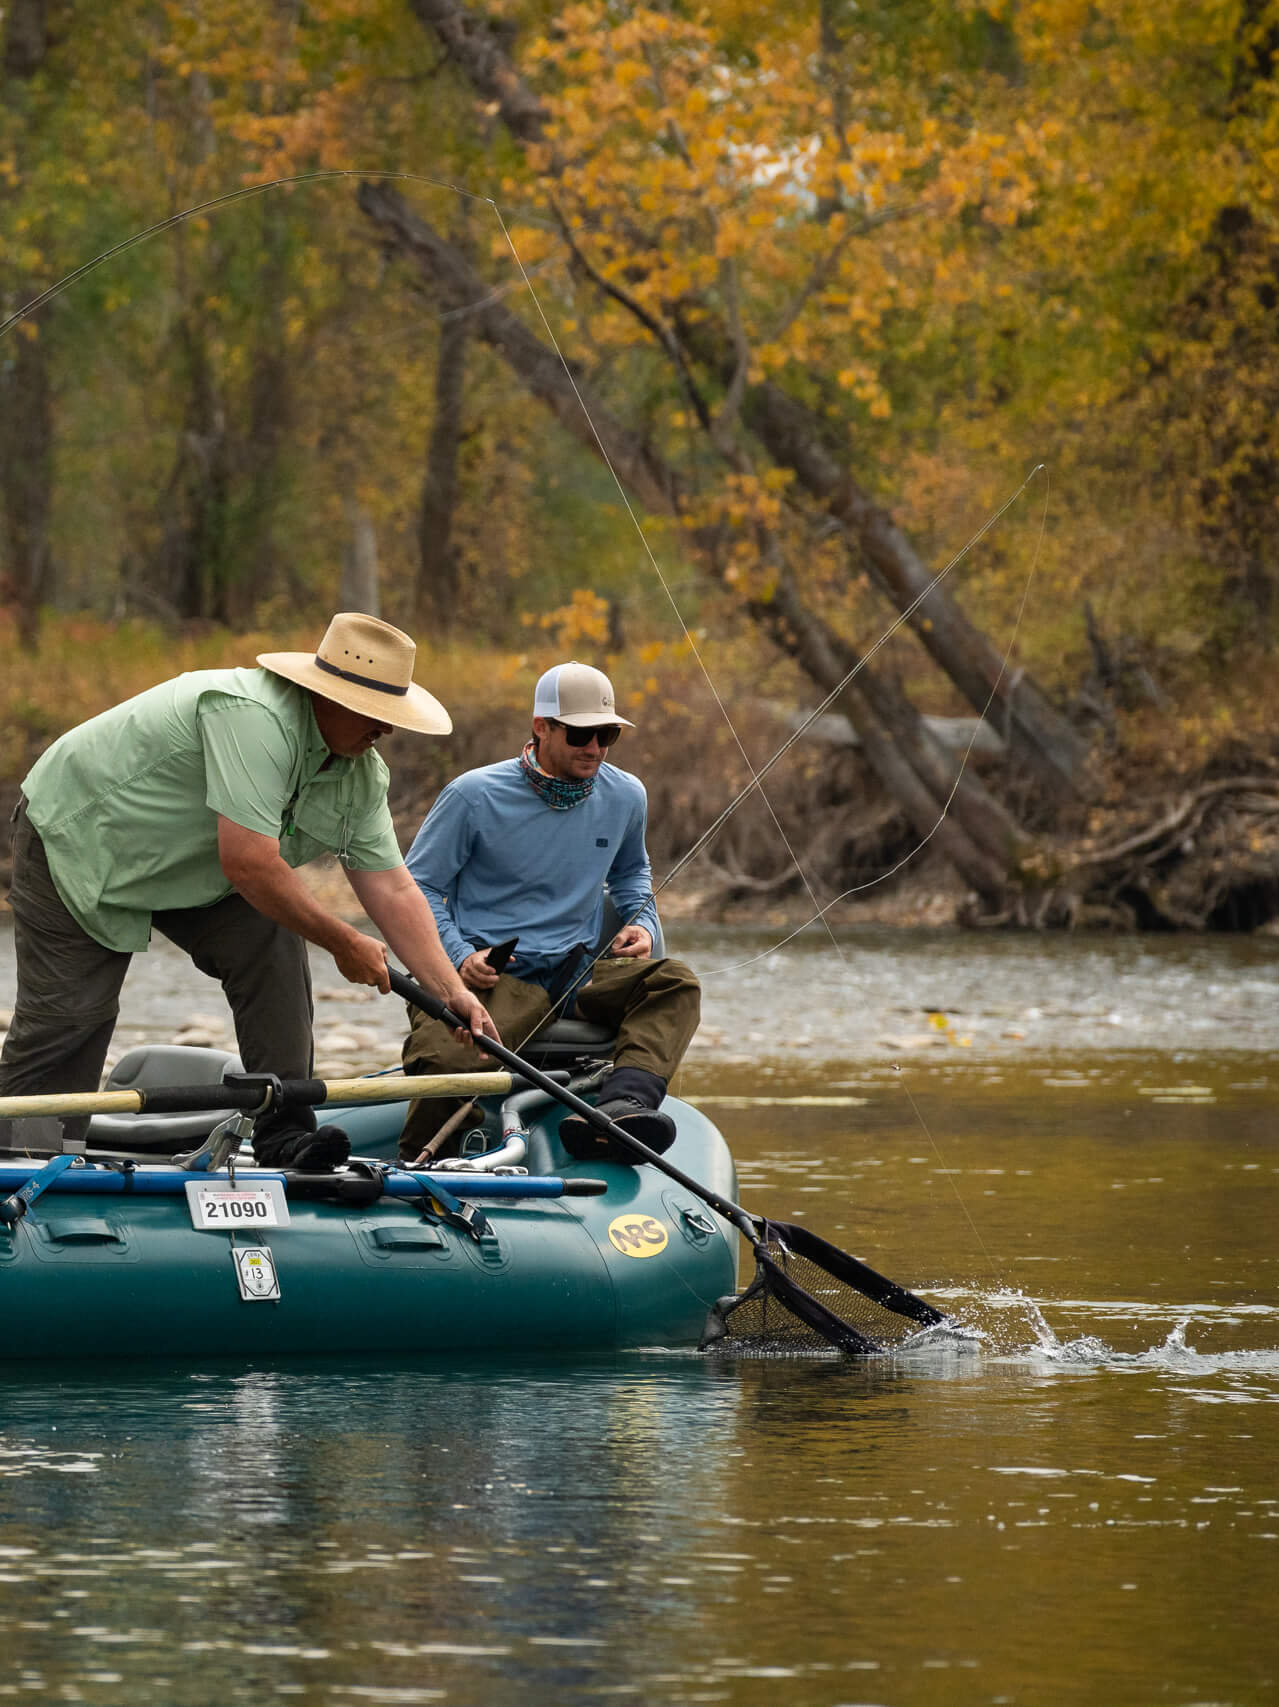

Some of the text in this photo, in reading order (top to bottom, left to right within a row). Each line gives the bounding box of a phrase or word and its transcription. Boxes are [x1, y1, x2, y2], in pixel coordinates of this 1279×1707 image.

[205, 1201, 267, 1218] 21090
[610, 1219, 666, 1252] NRS
[251, 1267, 264, 1280] 13
